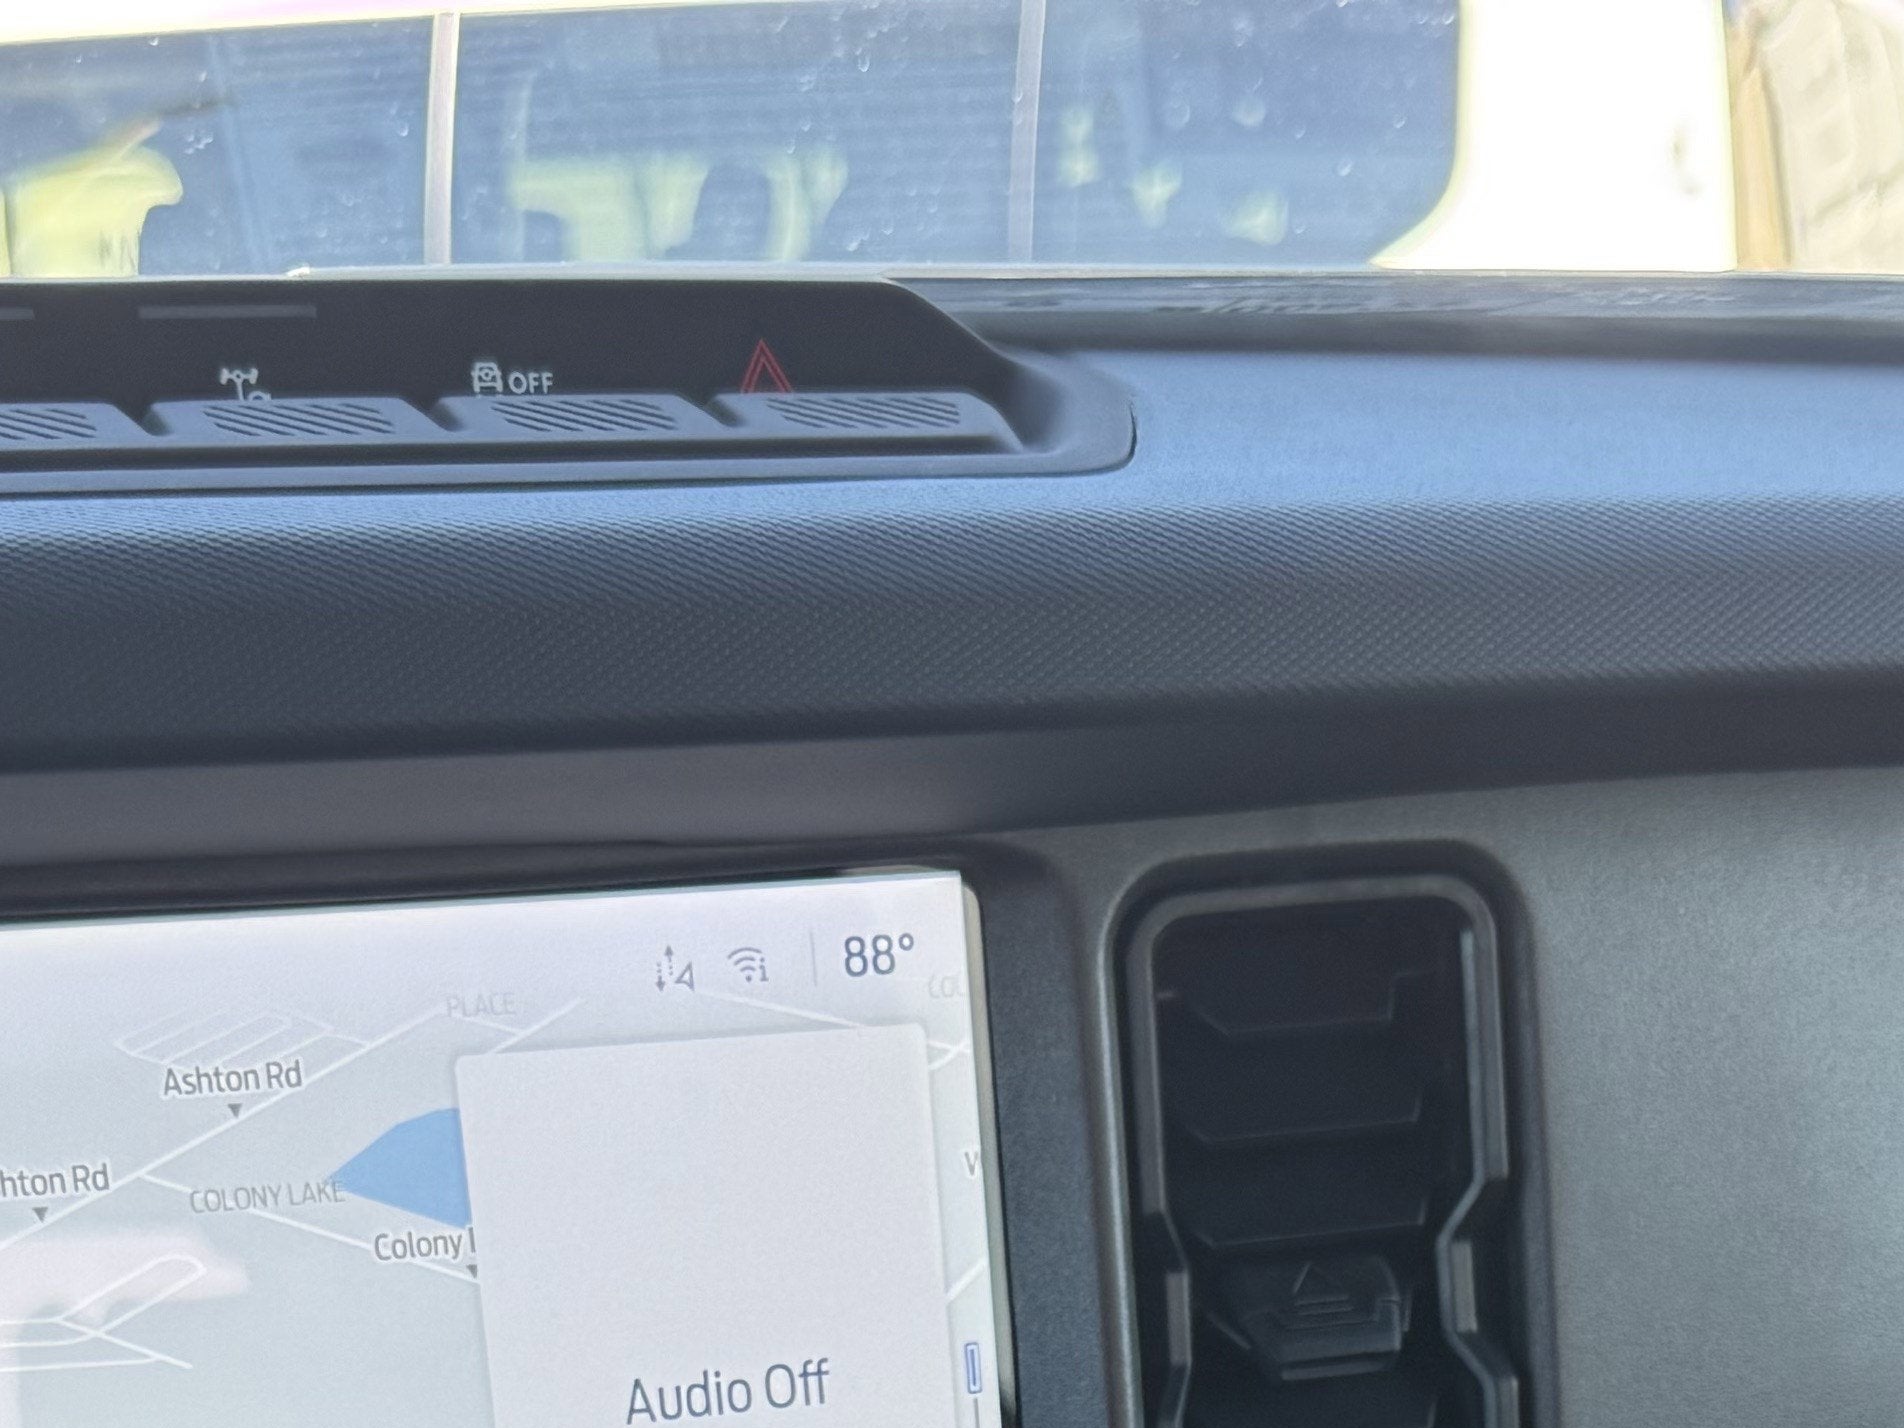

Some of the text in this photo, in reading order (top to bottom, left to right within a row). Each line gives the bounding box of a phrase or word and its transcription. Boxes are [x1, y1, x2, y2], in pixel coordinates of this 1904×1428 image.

[508, 371, 554, 394] OFF
[165, 1060, 301, 1094] Ashton Rd
[72, 1164, 111, 1191] Rd
[189, 1180, 344, 1213] COLONY LAKE
[375, 1233, 462, 1262] Colony
[627, 1358, 829, 1424] Audio Off
